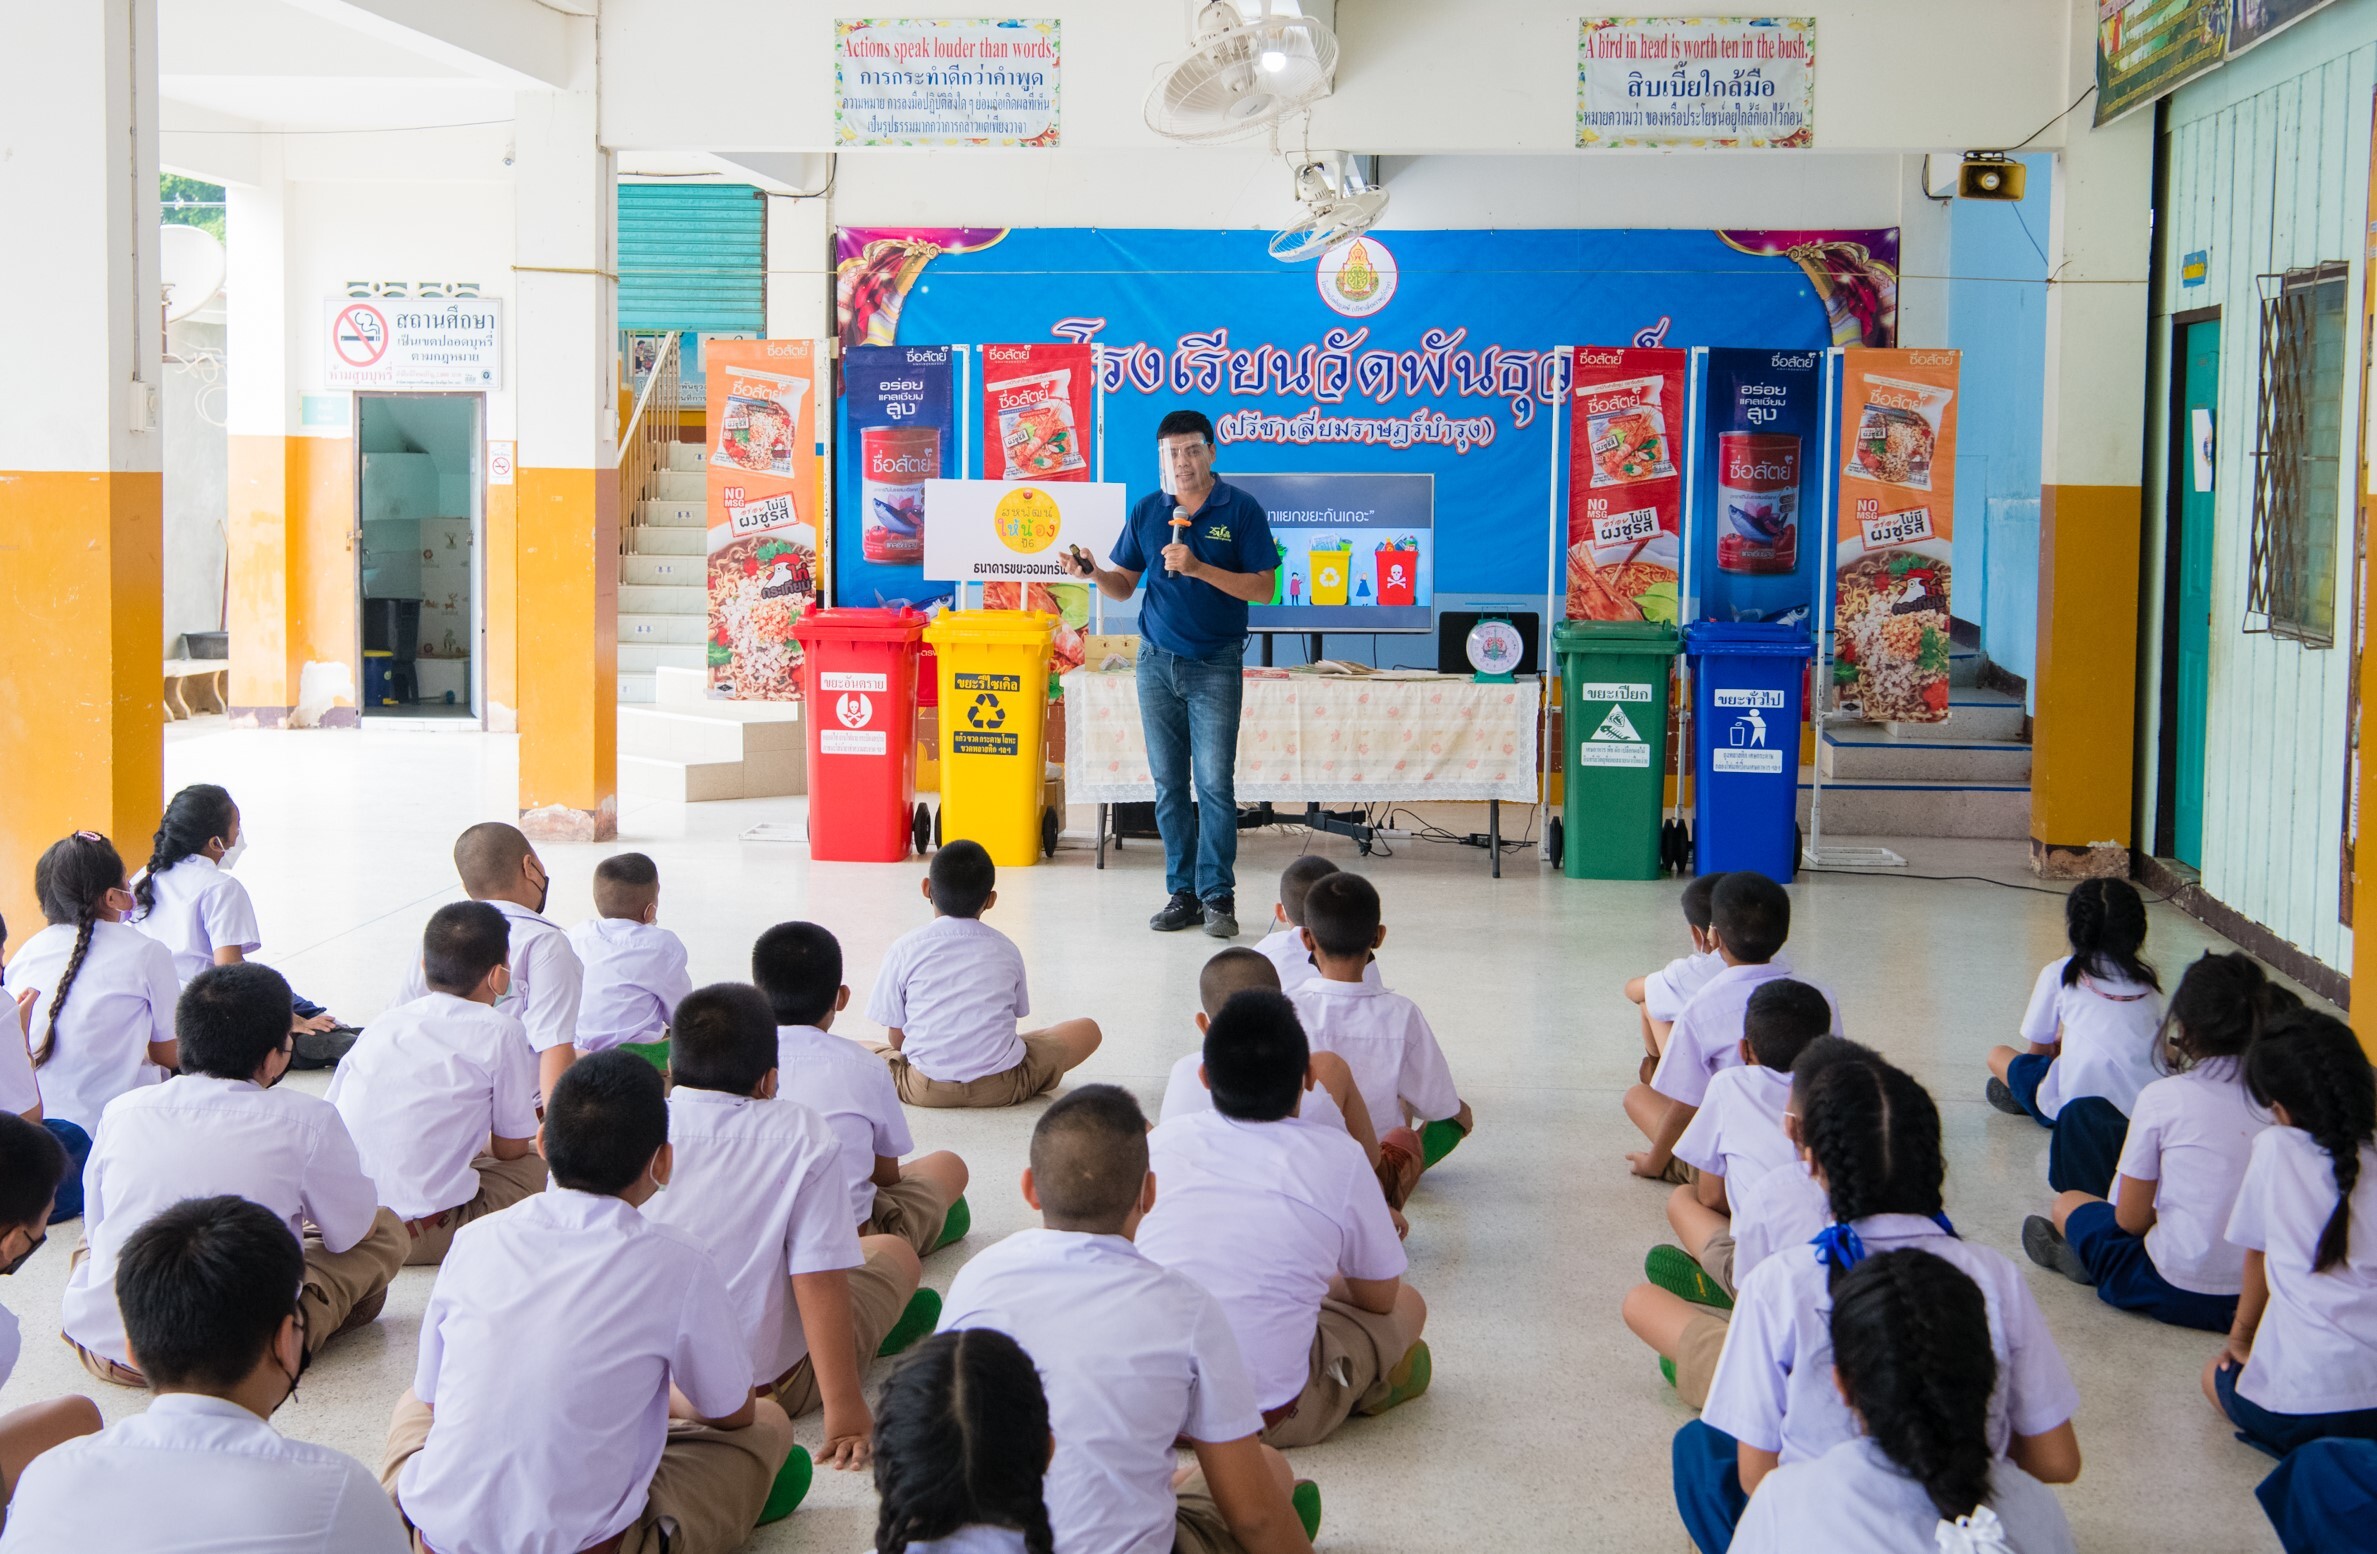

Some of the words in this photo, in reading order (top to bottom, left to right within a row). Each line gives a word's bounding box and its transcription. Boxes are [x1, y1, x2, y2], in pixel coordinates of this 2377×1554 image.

[843, 37, 890, 58] Actions
[894, 37, 929, 64] speak
[934, 37, 976, 58] louder
[979, 37, 1008, 58] than
[1012, 37, 1056, 58] words.
[1585, 34, 1594, 59] A
[1598, 33, 1622, 59] bird
[1625, 33, 1637, 59] in
[1640, 33, 1668, 59] head
[1671, 33, 1680, 59] is
[1684, 34, 1717, 59] worth
[1721, 35, 1739, 59] ten
[1742, 33, 1753, 59] in
[1756, 33, 1775, 59] the
[1777, 33, 1808, 59] bush.
[860, 64, 1043, 91] การกระทำดีกว่าคำพูด
[1627, 61, 1775, 97] สิบเบี้ยใกล้มือ
[1584, 106, 1643, 126] หมายความว่า
[397, 304, 495, 329] สถานศึกษา
[767, 341, 810, 357] ซื่อสัตย์
[906, 346, 949, 363] ซื่อสัตย์
[989, 344, 1032, 361] ซื่อสัตย์
[1579, 349, 1624, 365] ซื่อสัตย์
[1771, 352, 1816, 368] ซื่อสัตย์
[1909, 350, 1956, 366] ซื่อสัตย์
[732, 377, 788, 402] ซื่อสัตย์
[880, 377, 923, 391] อร่อย
[1741, 382, 1786, 395] อร่อย
[999, 382, 1051, 409] ซื่อสัตย์
[1588, 386, 1642, 413] ซื่อสัตย์
[1870, 386, 1929, 410] ซื่อสัตย์
[886, 403, 916, 419] สูง
[1747, 407, 1777, 425] สูง
[873, 447, 933, 473] ซื่อสัตย์
[1730, 455, 1793, 480] ซื่อสัตย์
[724, 488, 745, 500] NO
[724, 500, 745, 508] MSG
[765, 497, 787, 512] ไม่มี
[1587, 499, 1608, 511] NO
[1857, 500, 1878, 512] NO
[739, 507, 789, 527] ผงชูรส
[1587, 511, 1608, 519] MSG
[1629, 509, 1651, 523] ไม่มี
[1857, 512, 1878, 520] MSG
[1900, 511, 1922, 524] ไม่มี
[1601, 520, 1654, 540] ผงชูรส
[1871, 521, 1925, 542] ผงชูรส
[786, 562, 810, 582] ไก่
[761, 579, 812, 599] กระเทียม
[824, 674, 884, 690] ขยะอันตราย
[956, 675, 1018, 692] ขยะรีไซเคิล
[1587, 685, 1649, 701] ขยะเปียก
[1717, 690, 1782, 707] ขยะทั่วไป
